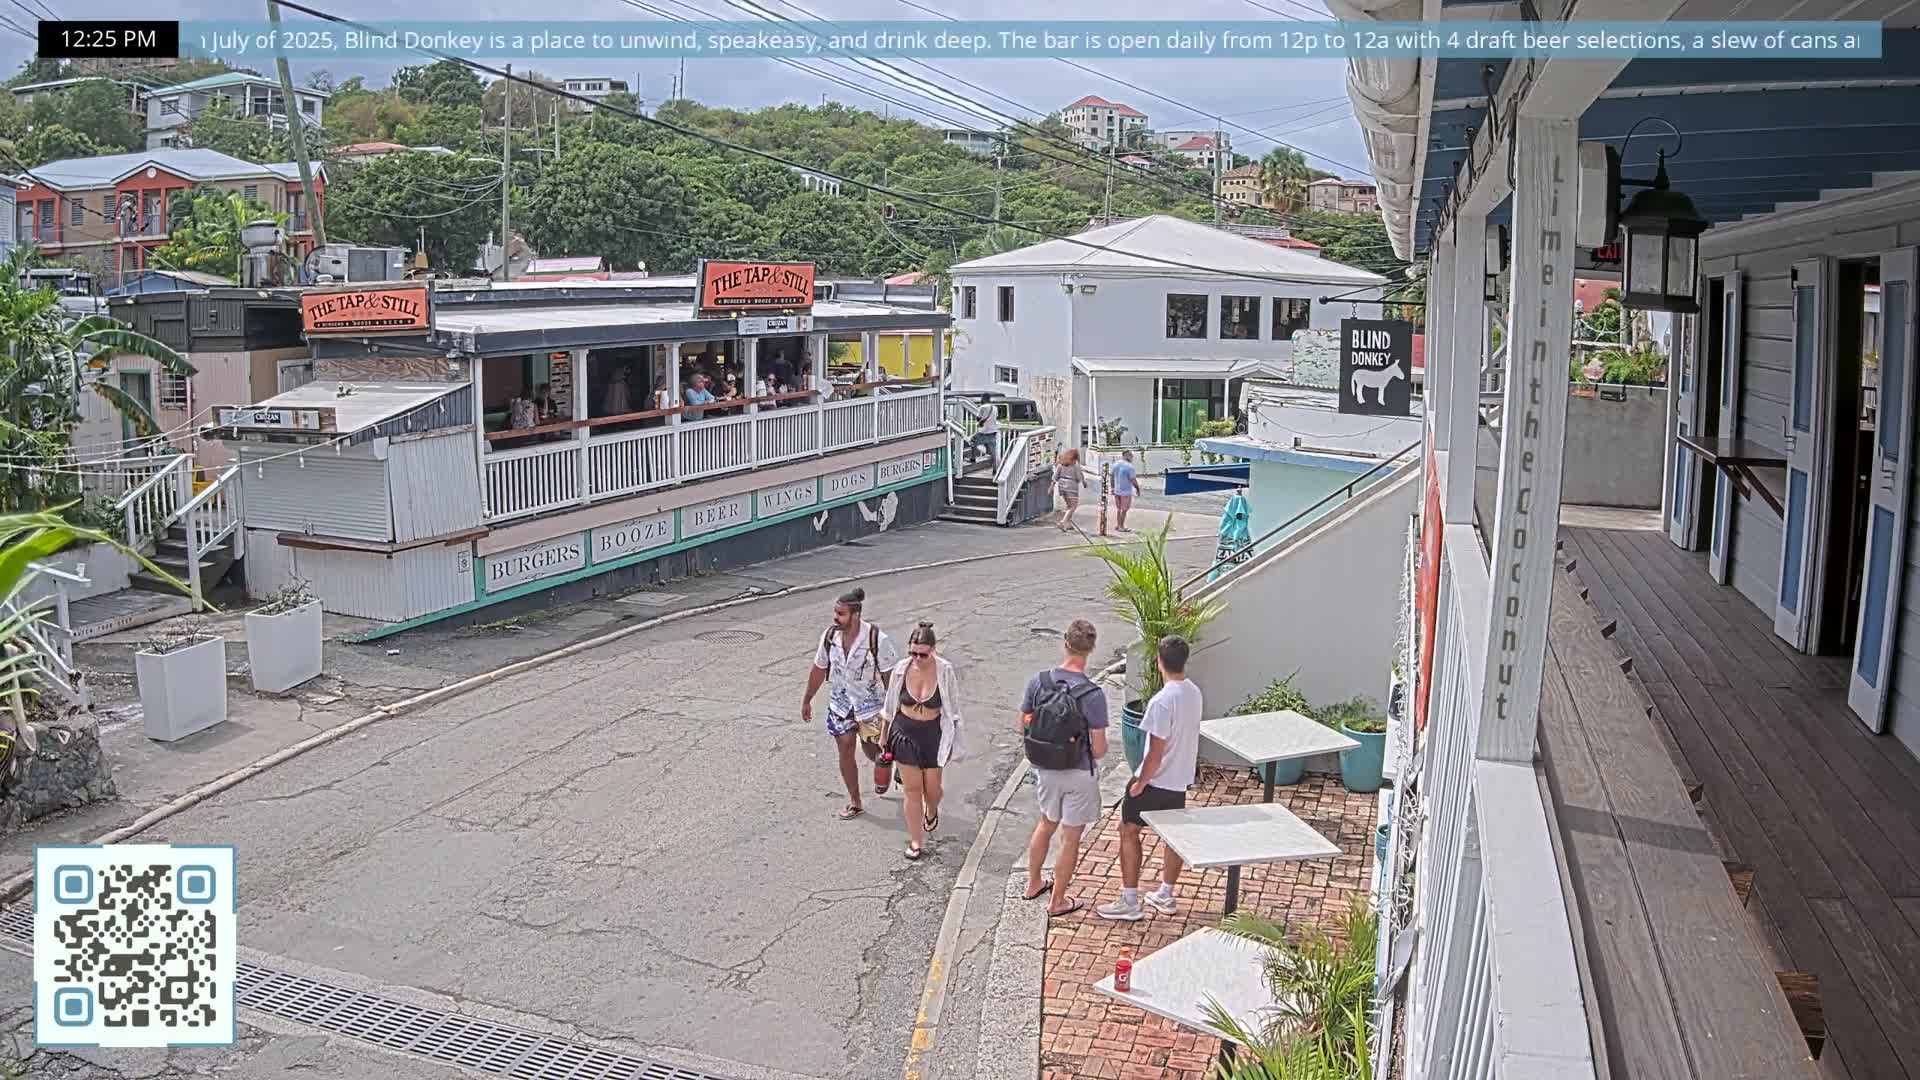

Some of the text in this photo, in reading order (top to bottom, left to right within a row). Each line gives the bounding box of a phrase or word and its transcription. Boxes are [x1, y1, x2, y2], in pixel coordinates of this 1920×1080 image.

[712, 270, 742, 296] THE
[744, 266, 770, 284] TAP
[783, 270, 809, 296] STILL
[308, 299, 337, 320] THE
[337, 294, 365, 310] TAP
[381, 295, 420, 318] STILL
[1352, 329, 1391, 350] BLIND
[1351, 351, 1392, 366] DONKEY
[879, 457, 922, 479] BURGERS
[831, 471, 868, 492] DOGS
[763, 485, 813, 508] WINGS
[694, 503, 740, 527] BEER
[600, 520, 668, 552] BOOZE
[492, 543, 580, 581] BURGERS
[1118, 973, 1127, 982] G
